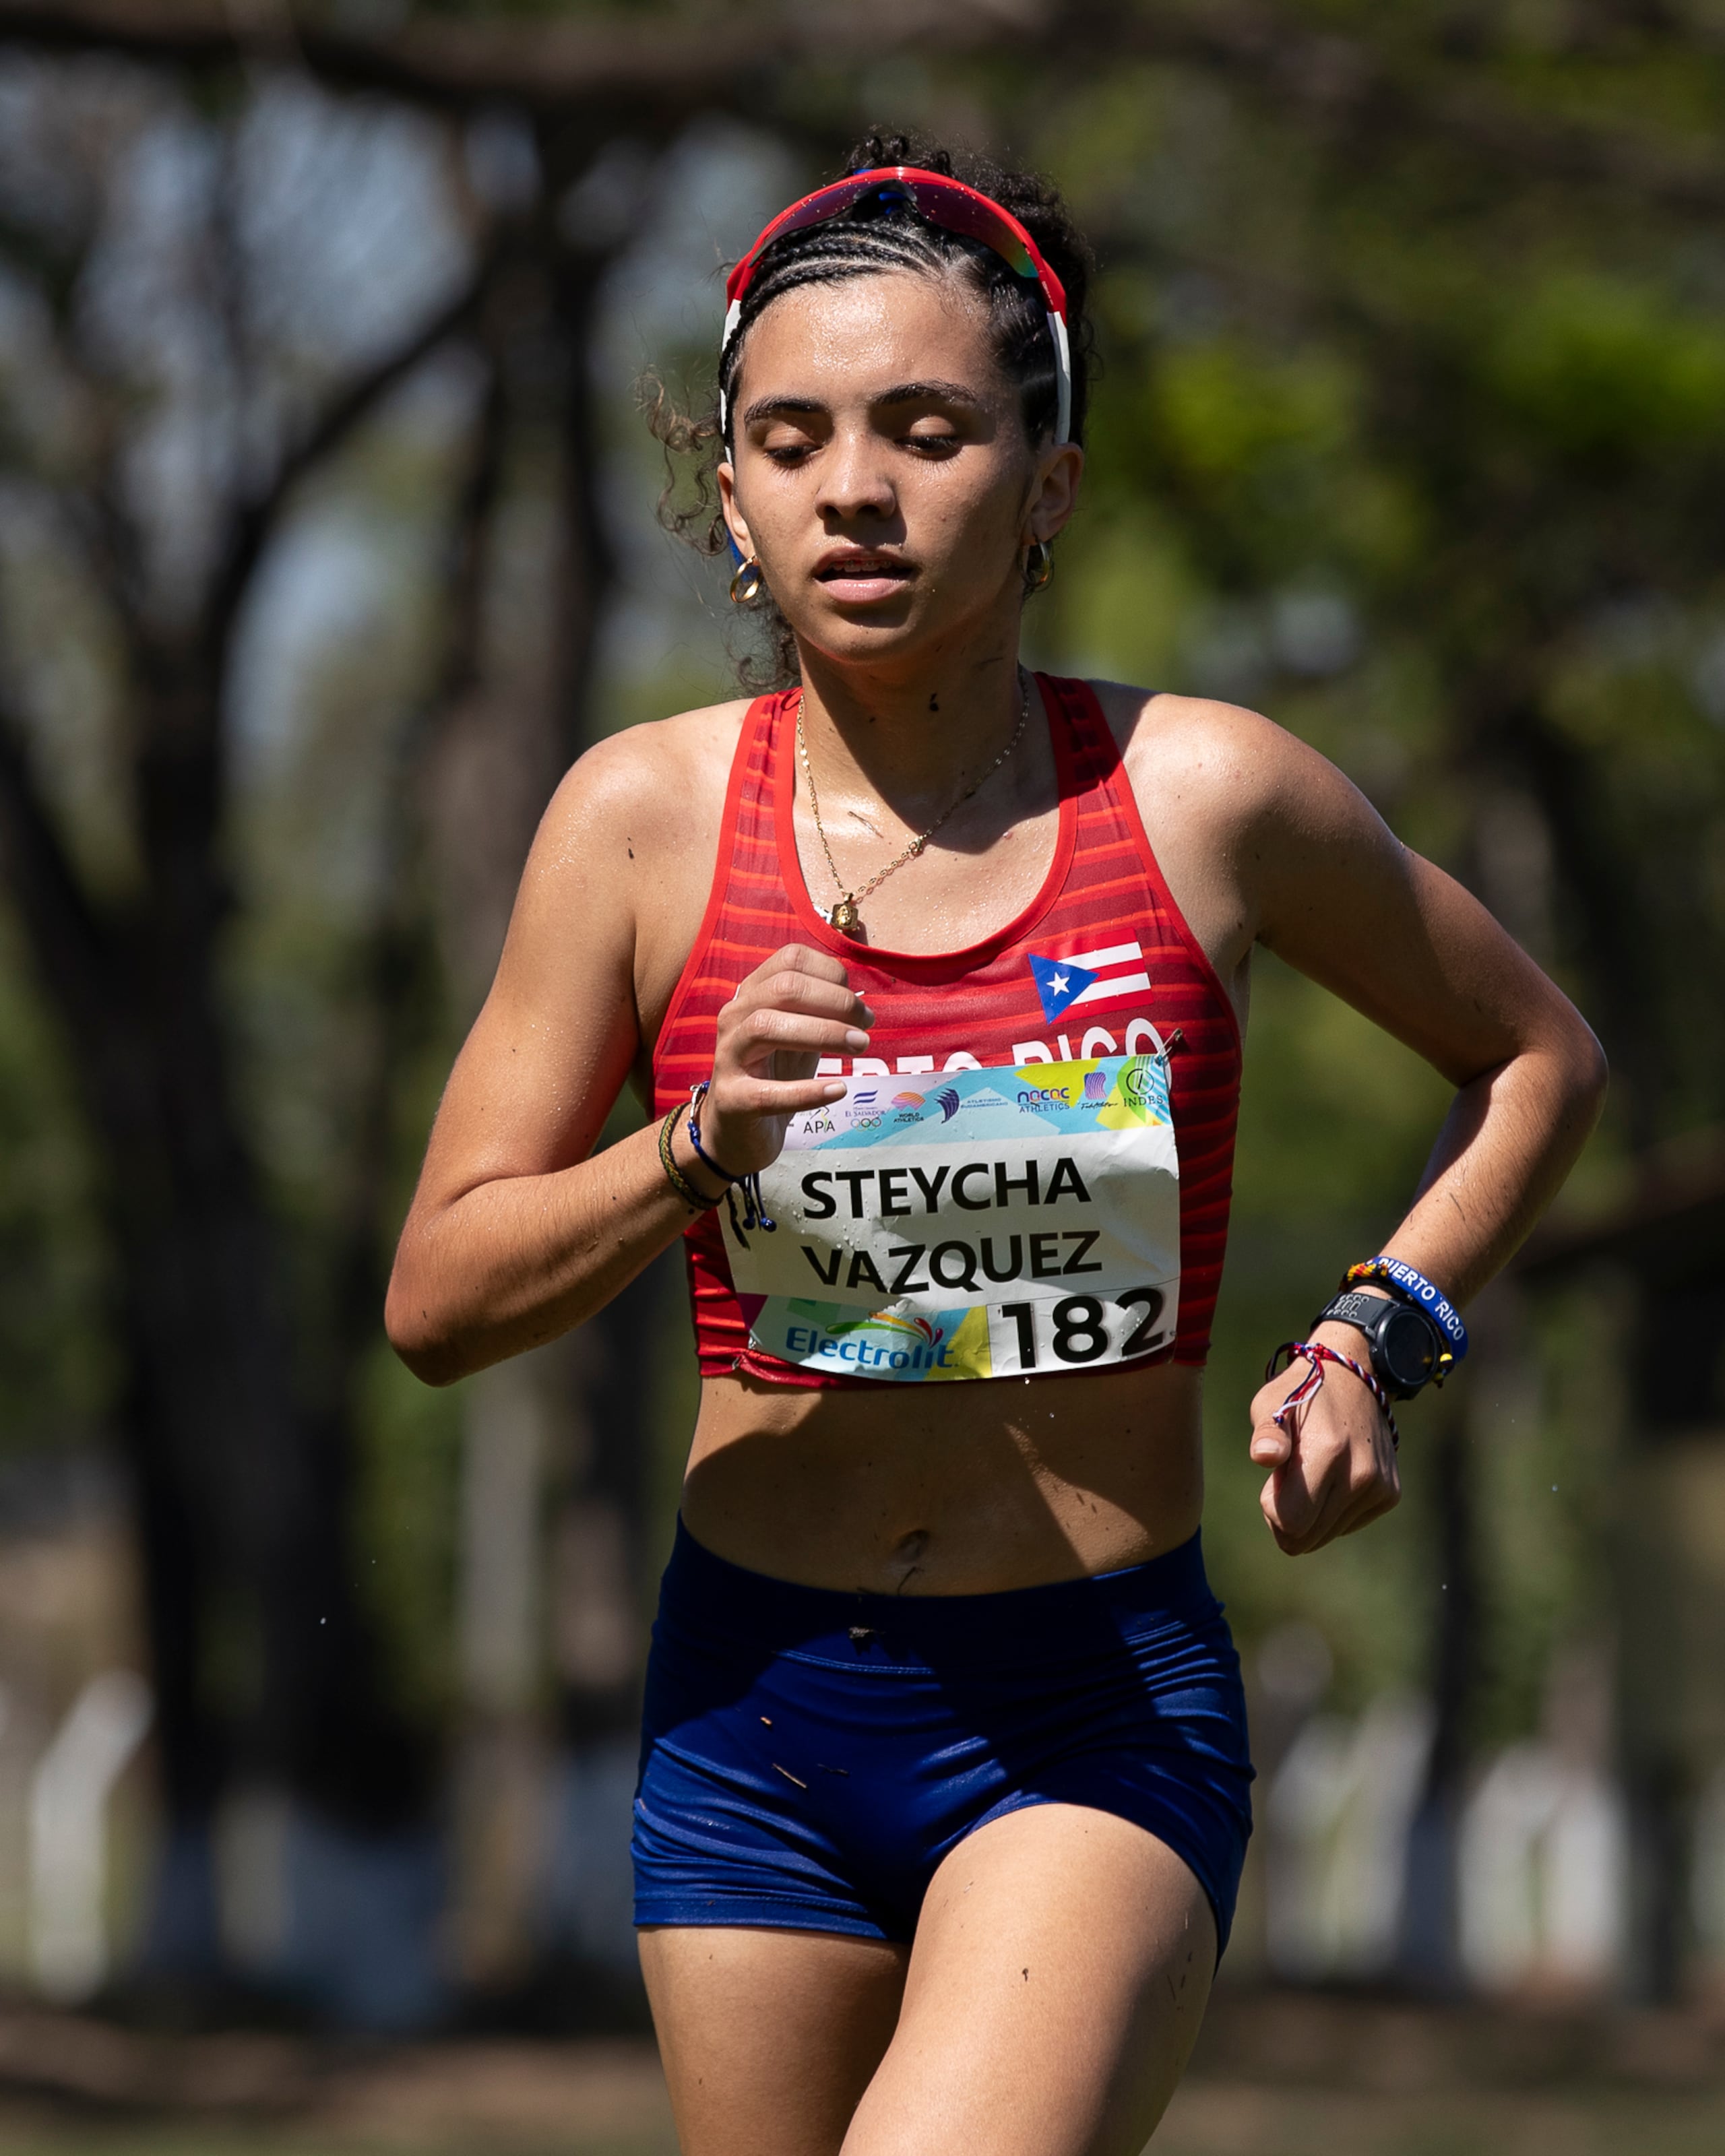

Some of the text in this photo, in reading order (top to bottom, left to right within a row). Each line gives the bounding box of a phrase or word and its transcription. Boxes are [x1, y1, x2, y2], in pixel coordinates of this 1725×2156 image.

[853, 1110, 886, 1118] SALVADOR
[1019, 1102, 1070, 1114] ATHLETICS
[1123, 1095, 1164, 1107] INDES
[803, 1120, 836, 1134] APA
[801, 1156, 1091, 1220] STEYCHA
[801, 1230, 1103, 1295] VAZQUEZ
[1002, 1288, 1164, 1370] 182
[1435, 1300, 1464, 1341] RICO
[786, 1326, 954, 1369] Electrolit
